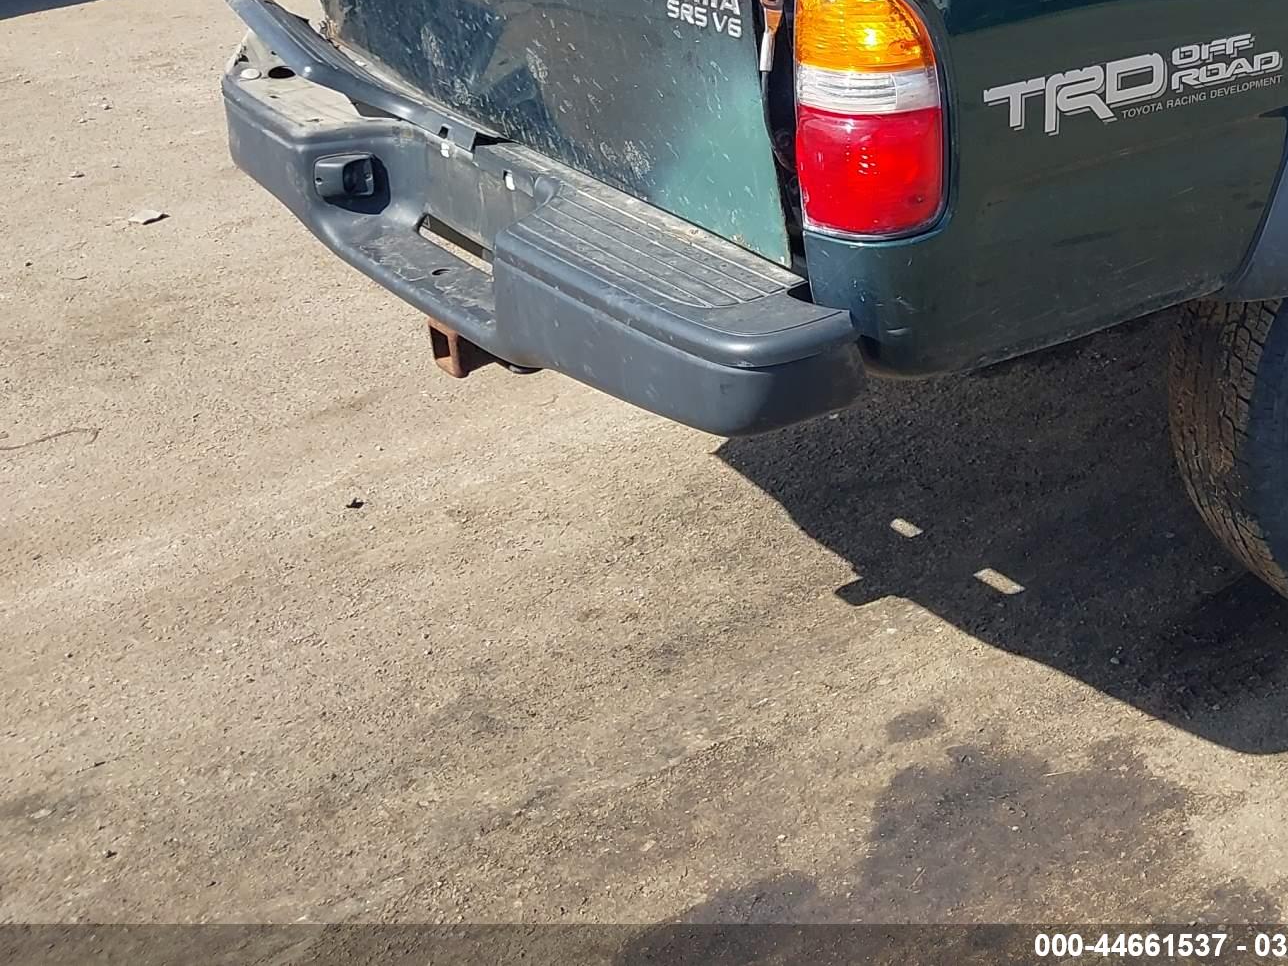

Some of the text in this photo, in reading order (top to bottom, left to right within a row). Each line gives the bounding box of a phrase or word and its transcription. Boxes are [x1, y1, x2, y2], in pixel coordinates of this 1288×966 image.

[666, 0, 742, 38] SR5 V6
[1171, 33, 1256, 68] OFF
[1171, 51, 1283, 93] ROAD
[983, 52, 1168, 136] TRD
[1121, 74, 1283, 120] TOYOTA RACING DEVELOPMENT
